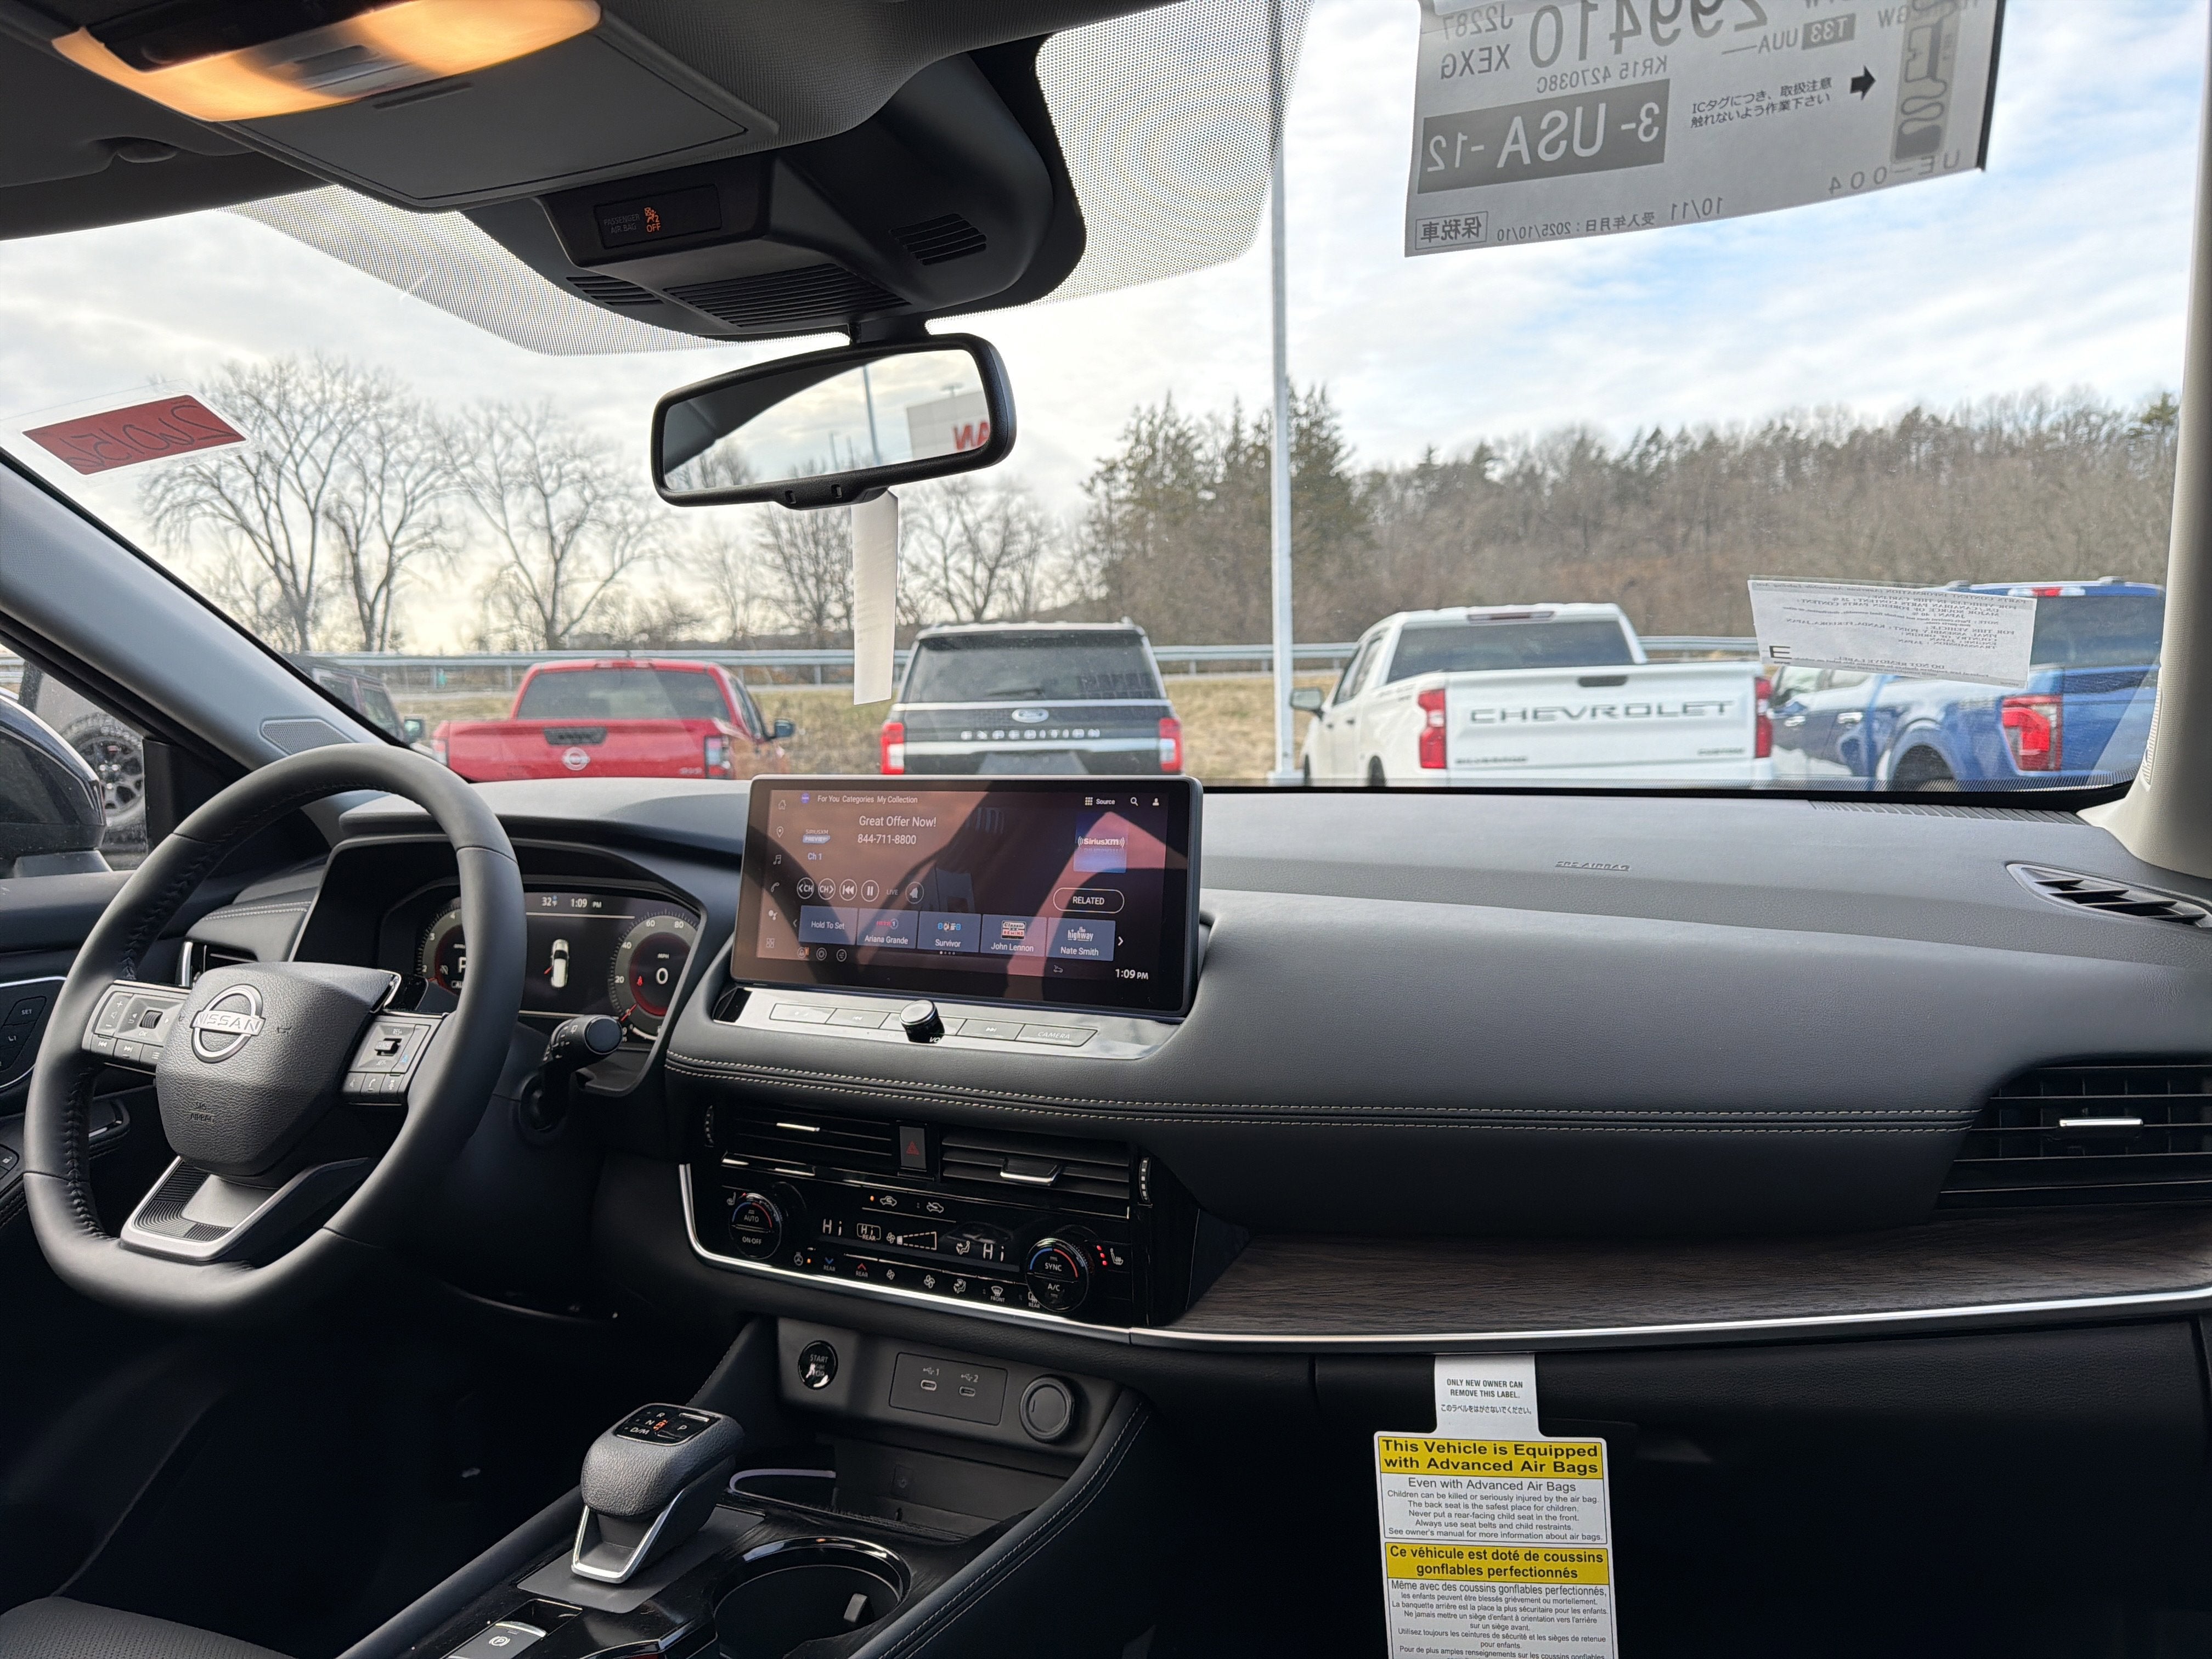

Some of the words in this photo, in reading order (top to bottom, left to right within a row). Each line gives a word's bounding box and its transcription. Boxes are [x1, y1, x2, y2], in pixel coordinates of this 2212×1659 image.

[604, 213, 640, 225] PASSENGER
[646, 223, 661, 233] OFF
[1471, 699, 1735, 724] CHEVROLET
[961, 728, 1101, 741] EXPEDITION
[842, 795, 874, 804] Categories
[877, 795, 887, 804] My
[859, 815, 884, 826] Great
[886, 815, 910, 826] Offer
[912, 816, 936, 827] Now!
[857, 833, 917, 845] 844-711-8800
[571, 898, 588, 908] 1:09
[1073, 896, 1105, 905] RELATED
[646, 919, 656, 928] 60
[834, 921, 845, 930] Set
[885, 936, 908, 944] Grande
[1067, 929, 1094, 941] highway
[935, 939, 961, 947] Survivor
[1009, 944, 1034, 953] Lennon
[1078, 947, 1098, 956] Smith
[1115, 969, 1136, 979] 1:09
[194, 1013, 260, 1032] NISSAN
[1037, 1031, 1071, 1039] CAMERA
[744, 1215, 759, 1223] AUTO
[1045, 1262, 1062, 1272] SYNC
[1047, 1283, 1060, 1291] A/C
[810, 1353, 828, 1363] START
[1441, 1404, 1532, 1414] このラベルをはがさないでください。
[1382, 1439, 1418, 1452] This
[1423, 1441, 1487, 1454] Vehicle
[1493, 1443, 1508, 1455] is
[1514, 1443, 1597, 1459] Equipped
[1384, 1457, 1420, 1469] with
[1426, 1457, 1513, 1471] Advanced
[1520, 1460, 1545, 1472] Air
[1553, 1461, 1598, 1476] Bags
[1408, 1477, 1436, 1487] Even
[1440, 1479, 1462, 1488] with
[1466, 1479, 1522, 1490] Advanced
[1527, 1481, 1543, 1491] Air
[1547, 1481, 1576, 1493] Bags
[1387, 1490, 1419, 1498] Children
[1480, 1493, 1514, 1502] seriously
[1516, 1494, 1542, 1503] injured
[1544, 1494, 1553, 1503] by
[1582, 1496, 1599, 1504] bag.
[1389, 1527, 1403, 1537] See
[1581, 1533, 1602, 1542] bags.
[1390, 1545, 1406, 1556] Ce
[1410, 1547, 1464, 1559] véhicule
[1468, 1549, 1487, 1560] est
[1491, 1549, 1519, 1561] doté
[1523, 1550, 1539, 1561] de
[1543, 1551, 1603, 1562] coussins
[1416, 1563, 1483, 1576] gonflables
[1487, 1565, 1577, 1578] perfectionnés
